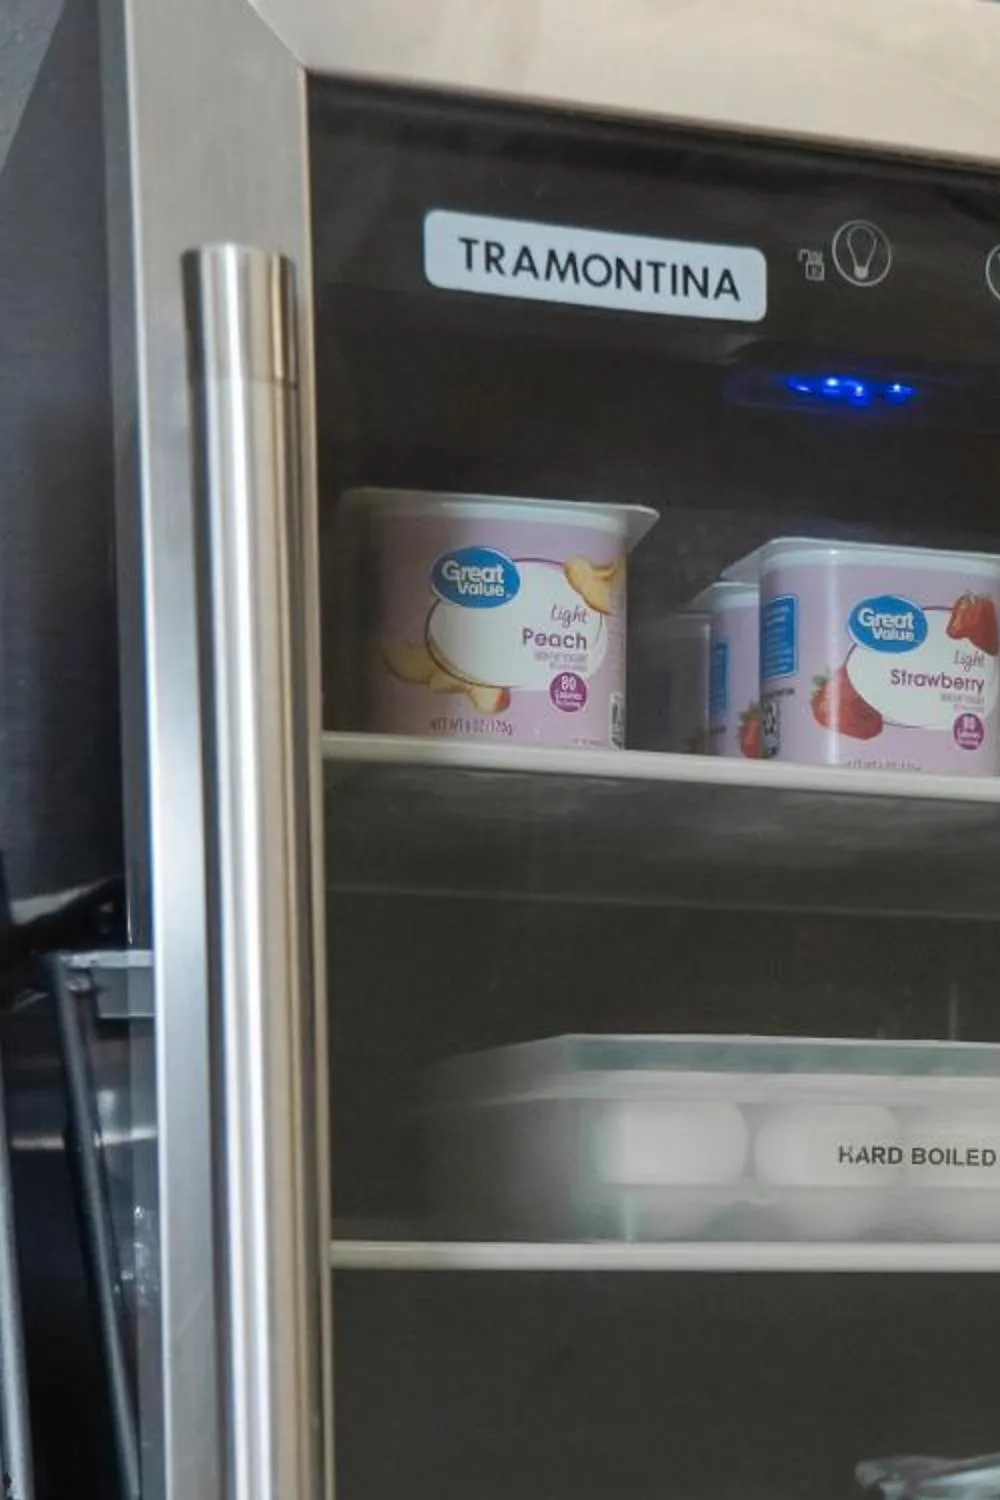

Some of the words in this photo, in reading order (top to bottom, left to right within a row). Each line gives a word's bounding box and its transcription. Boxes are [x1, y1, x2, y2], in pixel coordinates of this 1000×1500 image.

[458, 236, 740, 302] TRAMONTINA
[441, 561, 505, 581] Great
[457, 579, 505, 598] Value
[551, 604, 588, 628] Light
[858, 607, 914, 630] Great
[522, 629, 588, 650] Peach
[872, 626, 915, 642] Value
[953, 650, 985, 672] Light
[890, 668, 985, 695] Strawberry
[838, 1146, 903, 1166] HARD
[910, 1148, 997, 1167] BOILED
